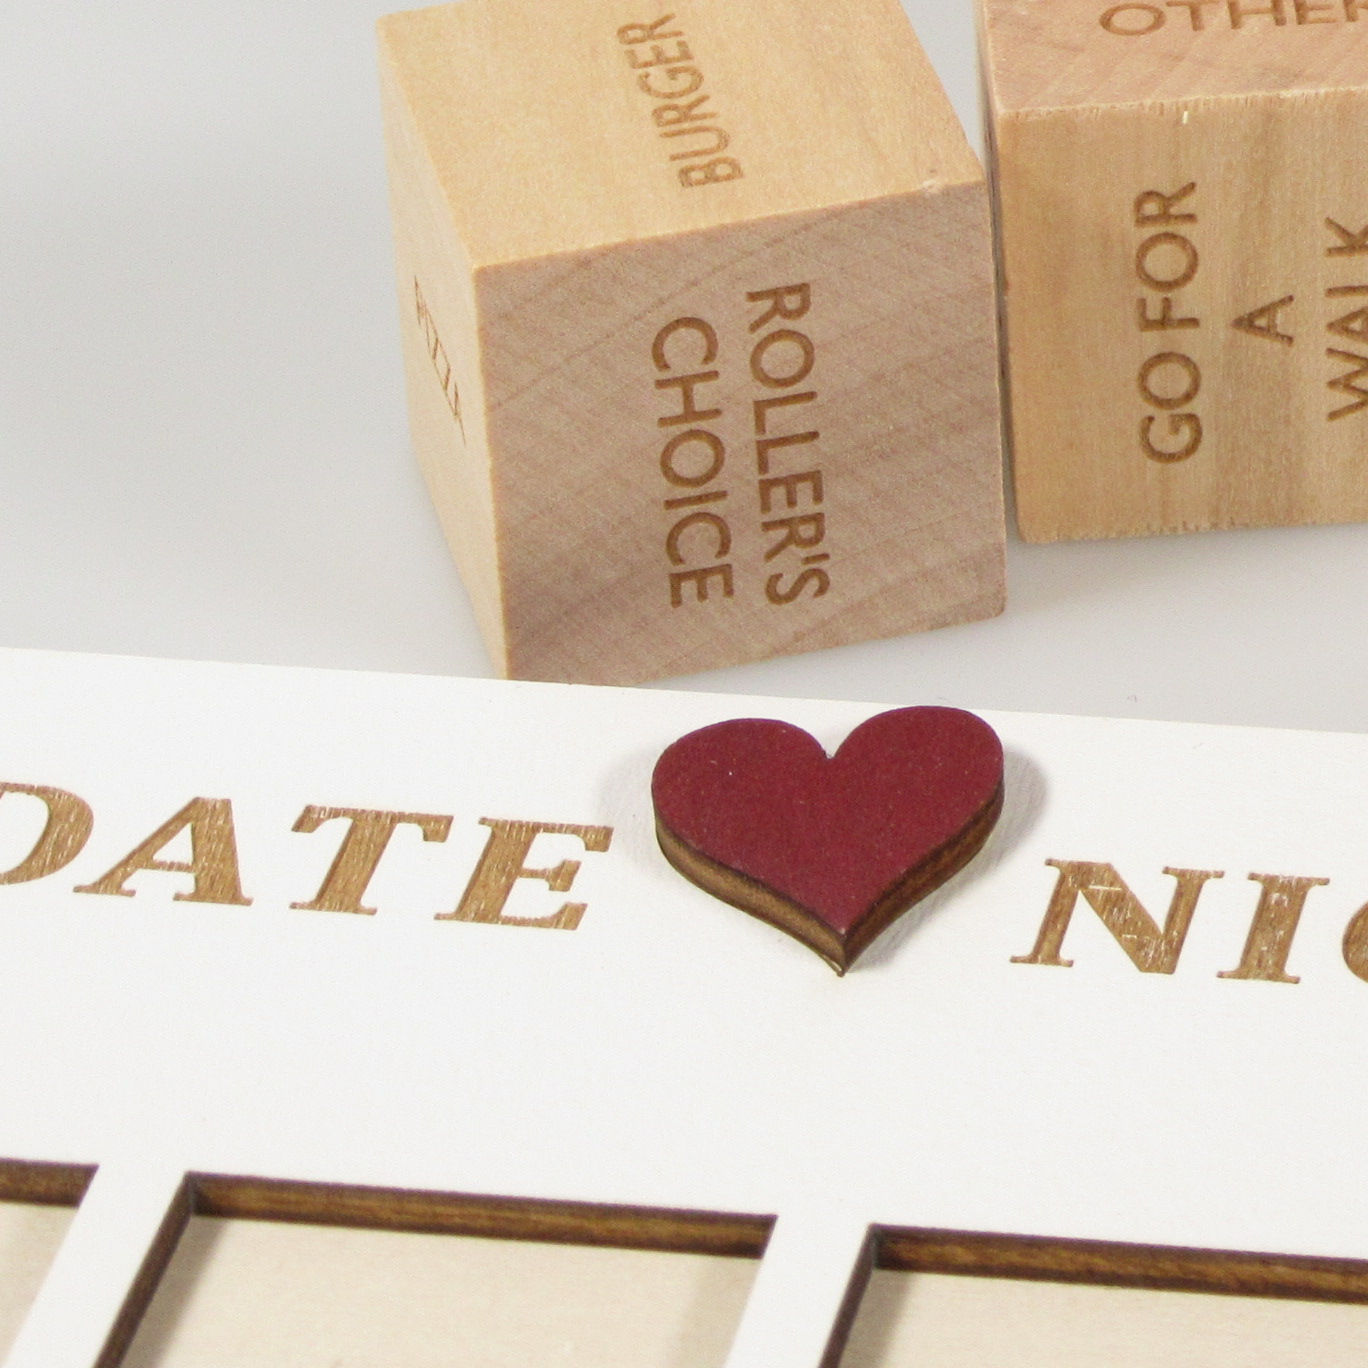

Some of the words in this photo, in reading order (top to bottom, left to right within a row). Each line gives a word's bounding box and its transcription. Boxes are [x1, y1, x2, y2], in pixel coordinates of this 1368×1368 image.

[615, 12, 743, 188] BURGER
[1133, 182, 1200, 333] FOR
[1231, 295, 1294, 346] A
[651, 316, 735, 608] CHOICE
[746, 281, 831, 606] ROLLER'S
[1136, 351, 1203, 464] GO
